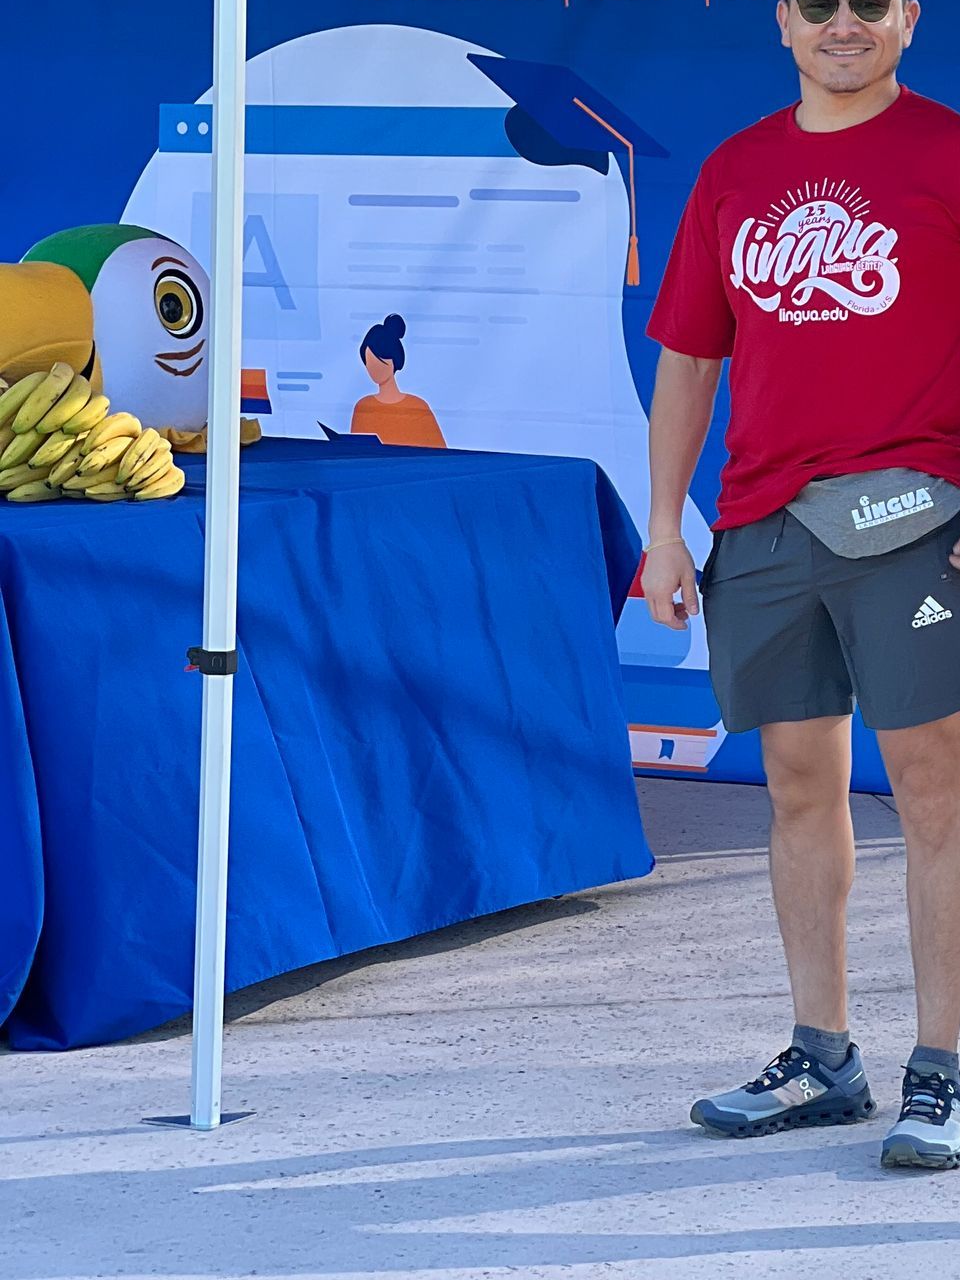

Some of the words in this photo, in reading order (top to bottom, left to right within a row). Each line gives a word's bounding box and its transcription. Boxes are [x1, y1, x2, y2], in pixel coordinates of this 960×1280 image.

[804, 204, 826, 218] 25
[798, 216, 831, 234] years
[847, 299, 875, 313] Florida
[778, 307, 849, 326] lingua.edu
[851, 488, 932, 524] LINGUA
[911, 609, 953, 629] adidas
